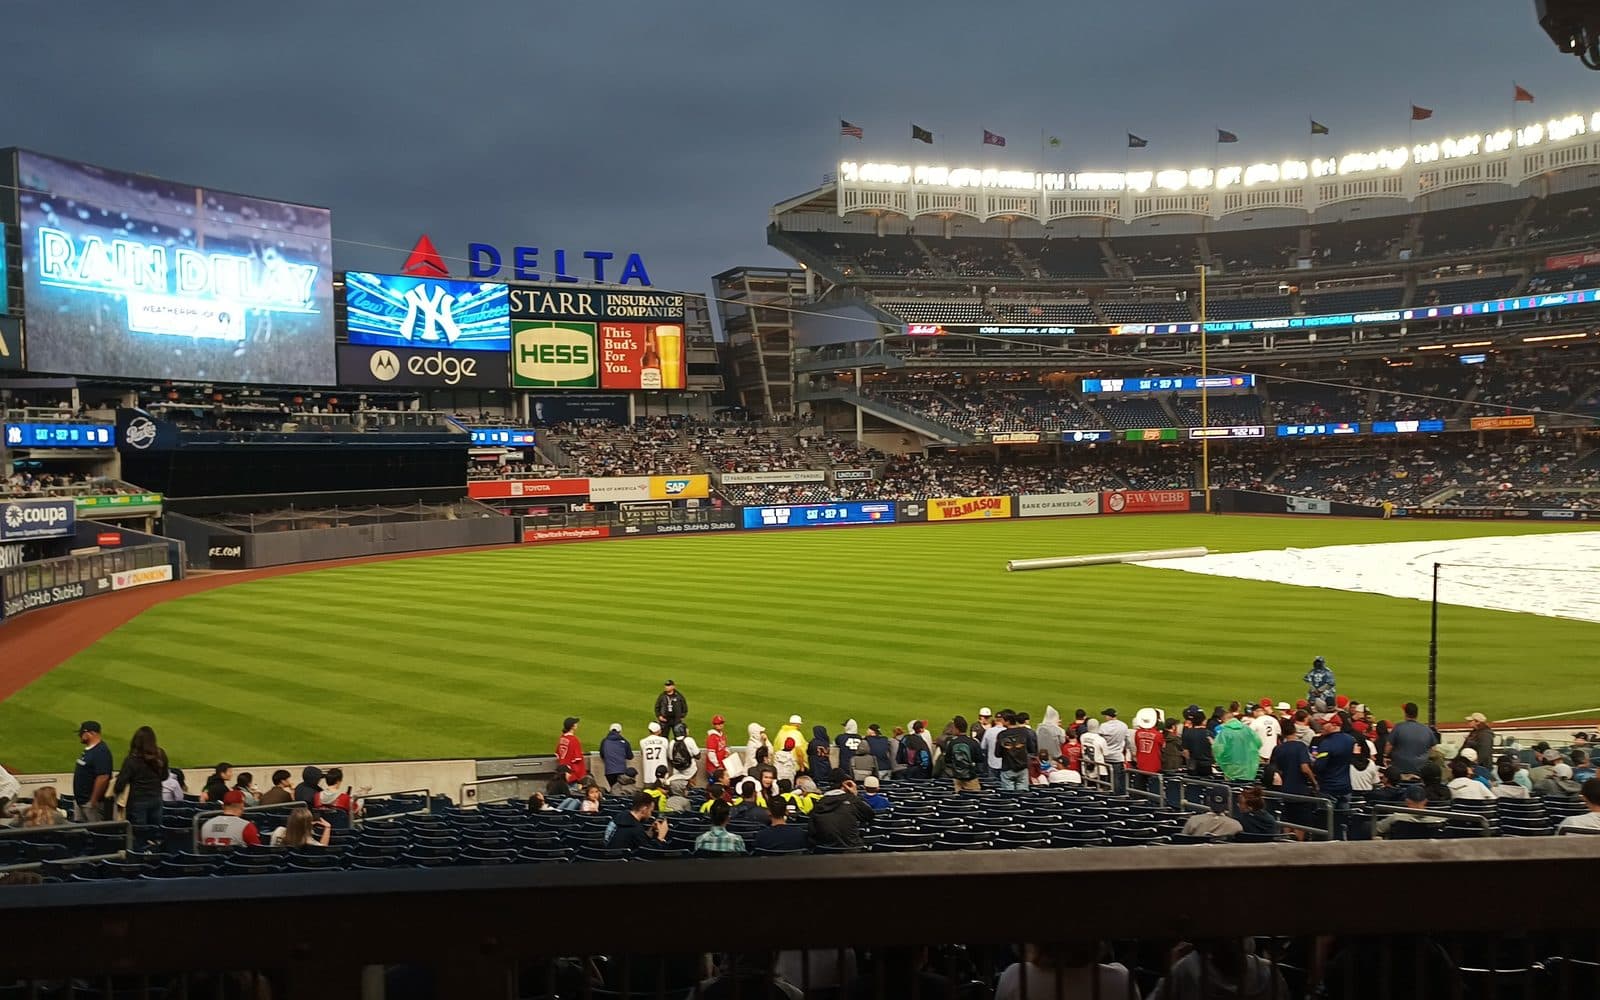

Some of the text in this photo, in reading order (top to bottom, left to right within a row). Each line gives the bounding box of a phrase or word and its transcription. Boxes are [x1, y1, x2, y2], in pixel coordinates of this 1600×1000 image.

[39, 227, 319, 310] RAIN DELAY
[468, 242, 651, 286] DELTA
[510, 290, 598, 316] STARR
[607, 294, 683, 307] INSURANCE
[607, 305, 683, 317] COMPANIES
[604, 327, 632, 338] This
[1203, 321, 1234, 332] FOLLOW
[604, 338, 638, 350] Bud's
[520, 344, 589, 364] HESS
[605, 351, 626, 362] For
[407, 351, 477, 384] edge
[605, 363, 632, 374] You.
[1083, 434, 1100, 442] edge
[666, 482, 686, 492] SAP
[1148, 491, 1184, 503] WEBB
[570, 503, 595, 513] FedEx
[24, 506, 67, 525] coupa
[710, 522, 736, 530] StubHub
[52, 584, 83, 601] StubHub
[1265, 727, 1273, 737] 2
[646, 748, 662, 760] 27
